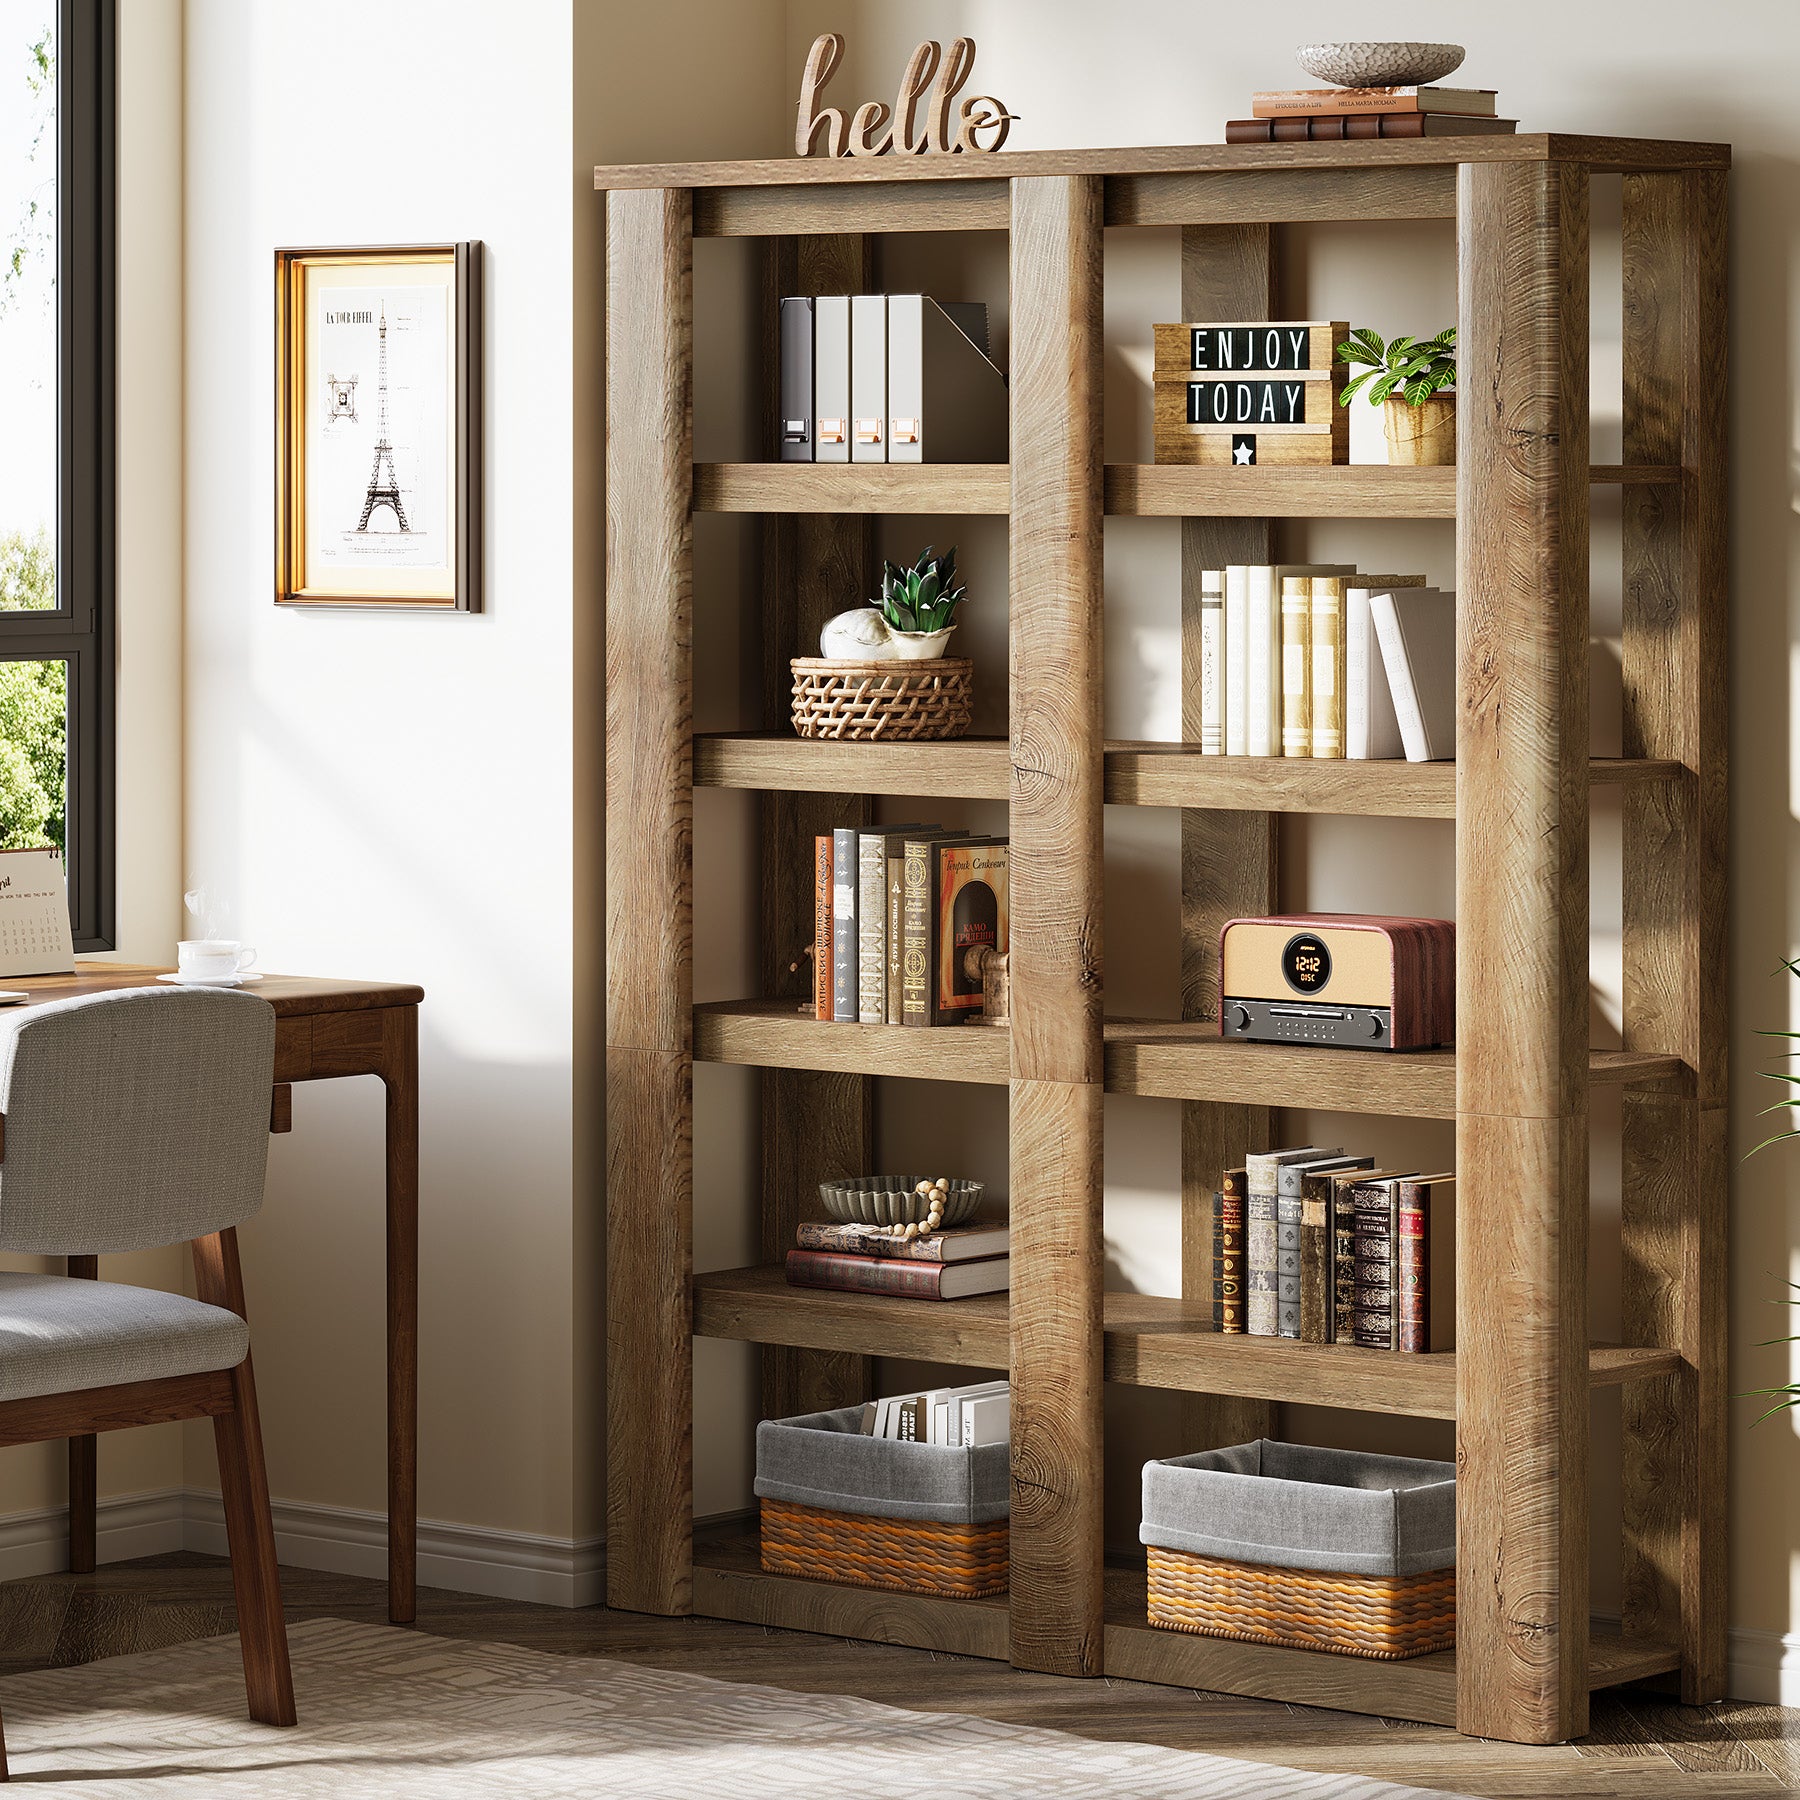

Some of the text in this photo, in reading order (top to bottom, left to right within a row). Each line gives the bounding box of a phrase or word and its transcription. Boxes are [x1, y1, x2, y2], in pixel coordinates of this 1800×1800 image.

[795, 33, 1021, 157] hello
[352, 311, 373, 324] EIFFEL
[1195, 329, 1305, 370] ENJOY
[1190, 382, 1301, 422] TODAY
[0, 876, 11, 890] ril
[963, 923, 987, 932] КАМО
[1295, 956, 1321, 972] 12:12
[819, 960, 827, 1012] ЗАПИСКИ
